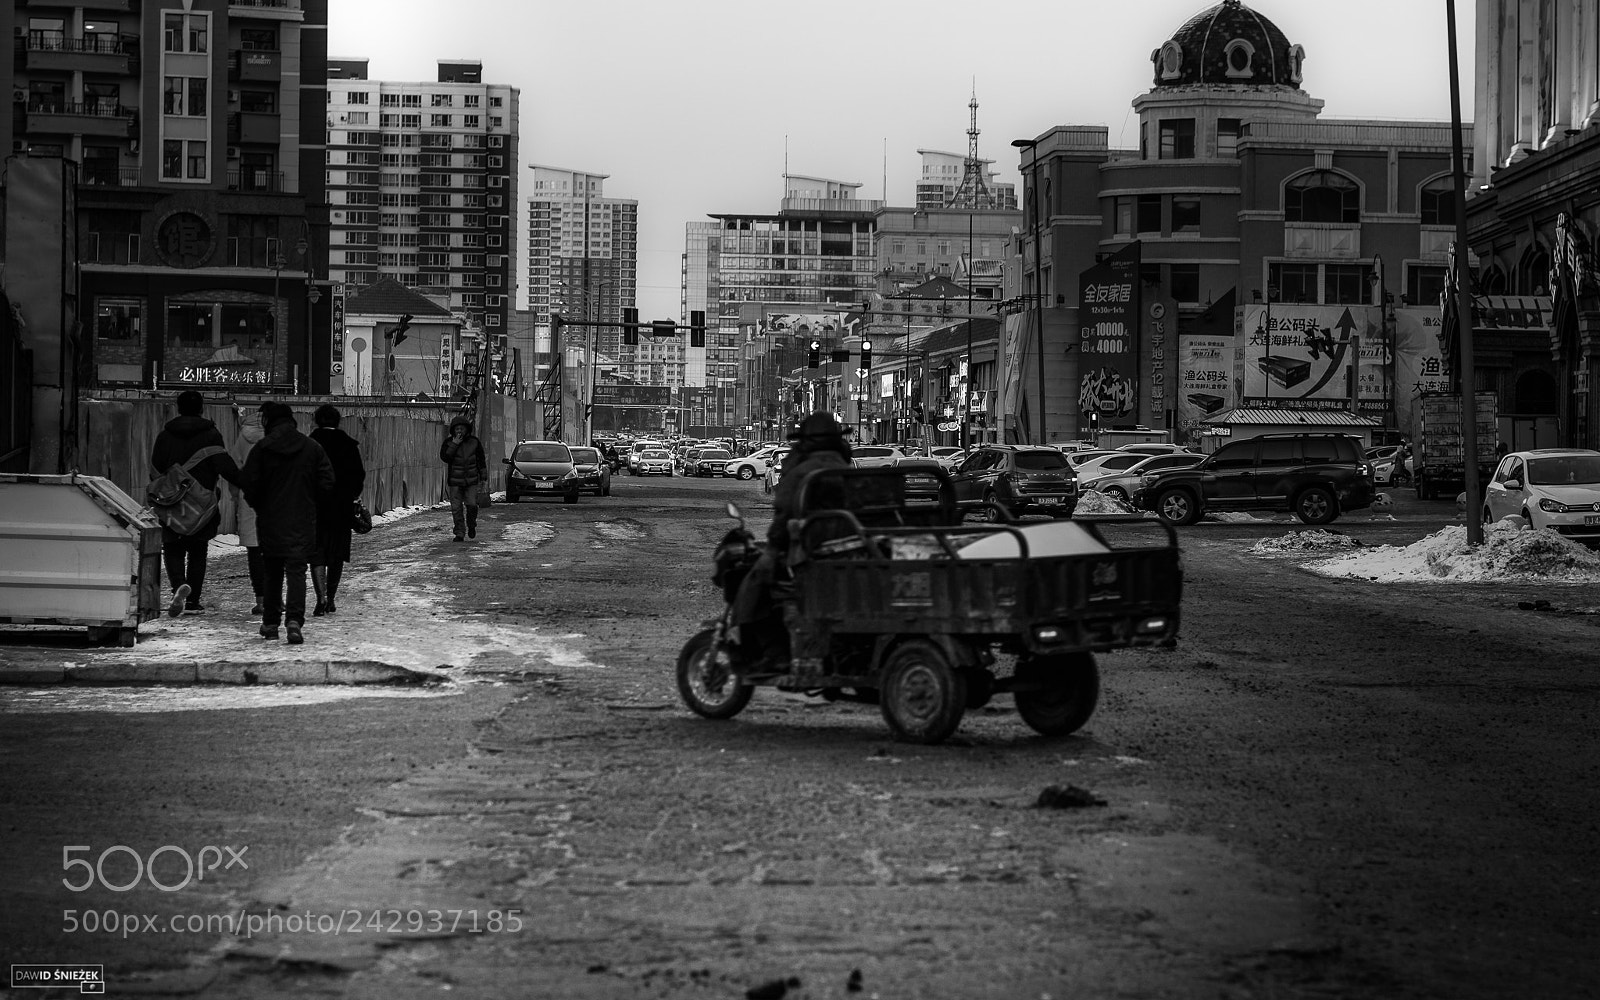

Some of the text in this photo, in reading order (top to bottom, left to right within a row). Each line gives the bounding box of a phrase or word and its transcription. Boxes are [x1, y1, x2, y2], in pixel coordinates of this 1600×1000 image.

[1084, 283, 1132, 303] 全友家居
[334, 300, 342, 352] 汽车停车场
[1184, 370, 1228, 382] 渔公码头
